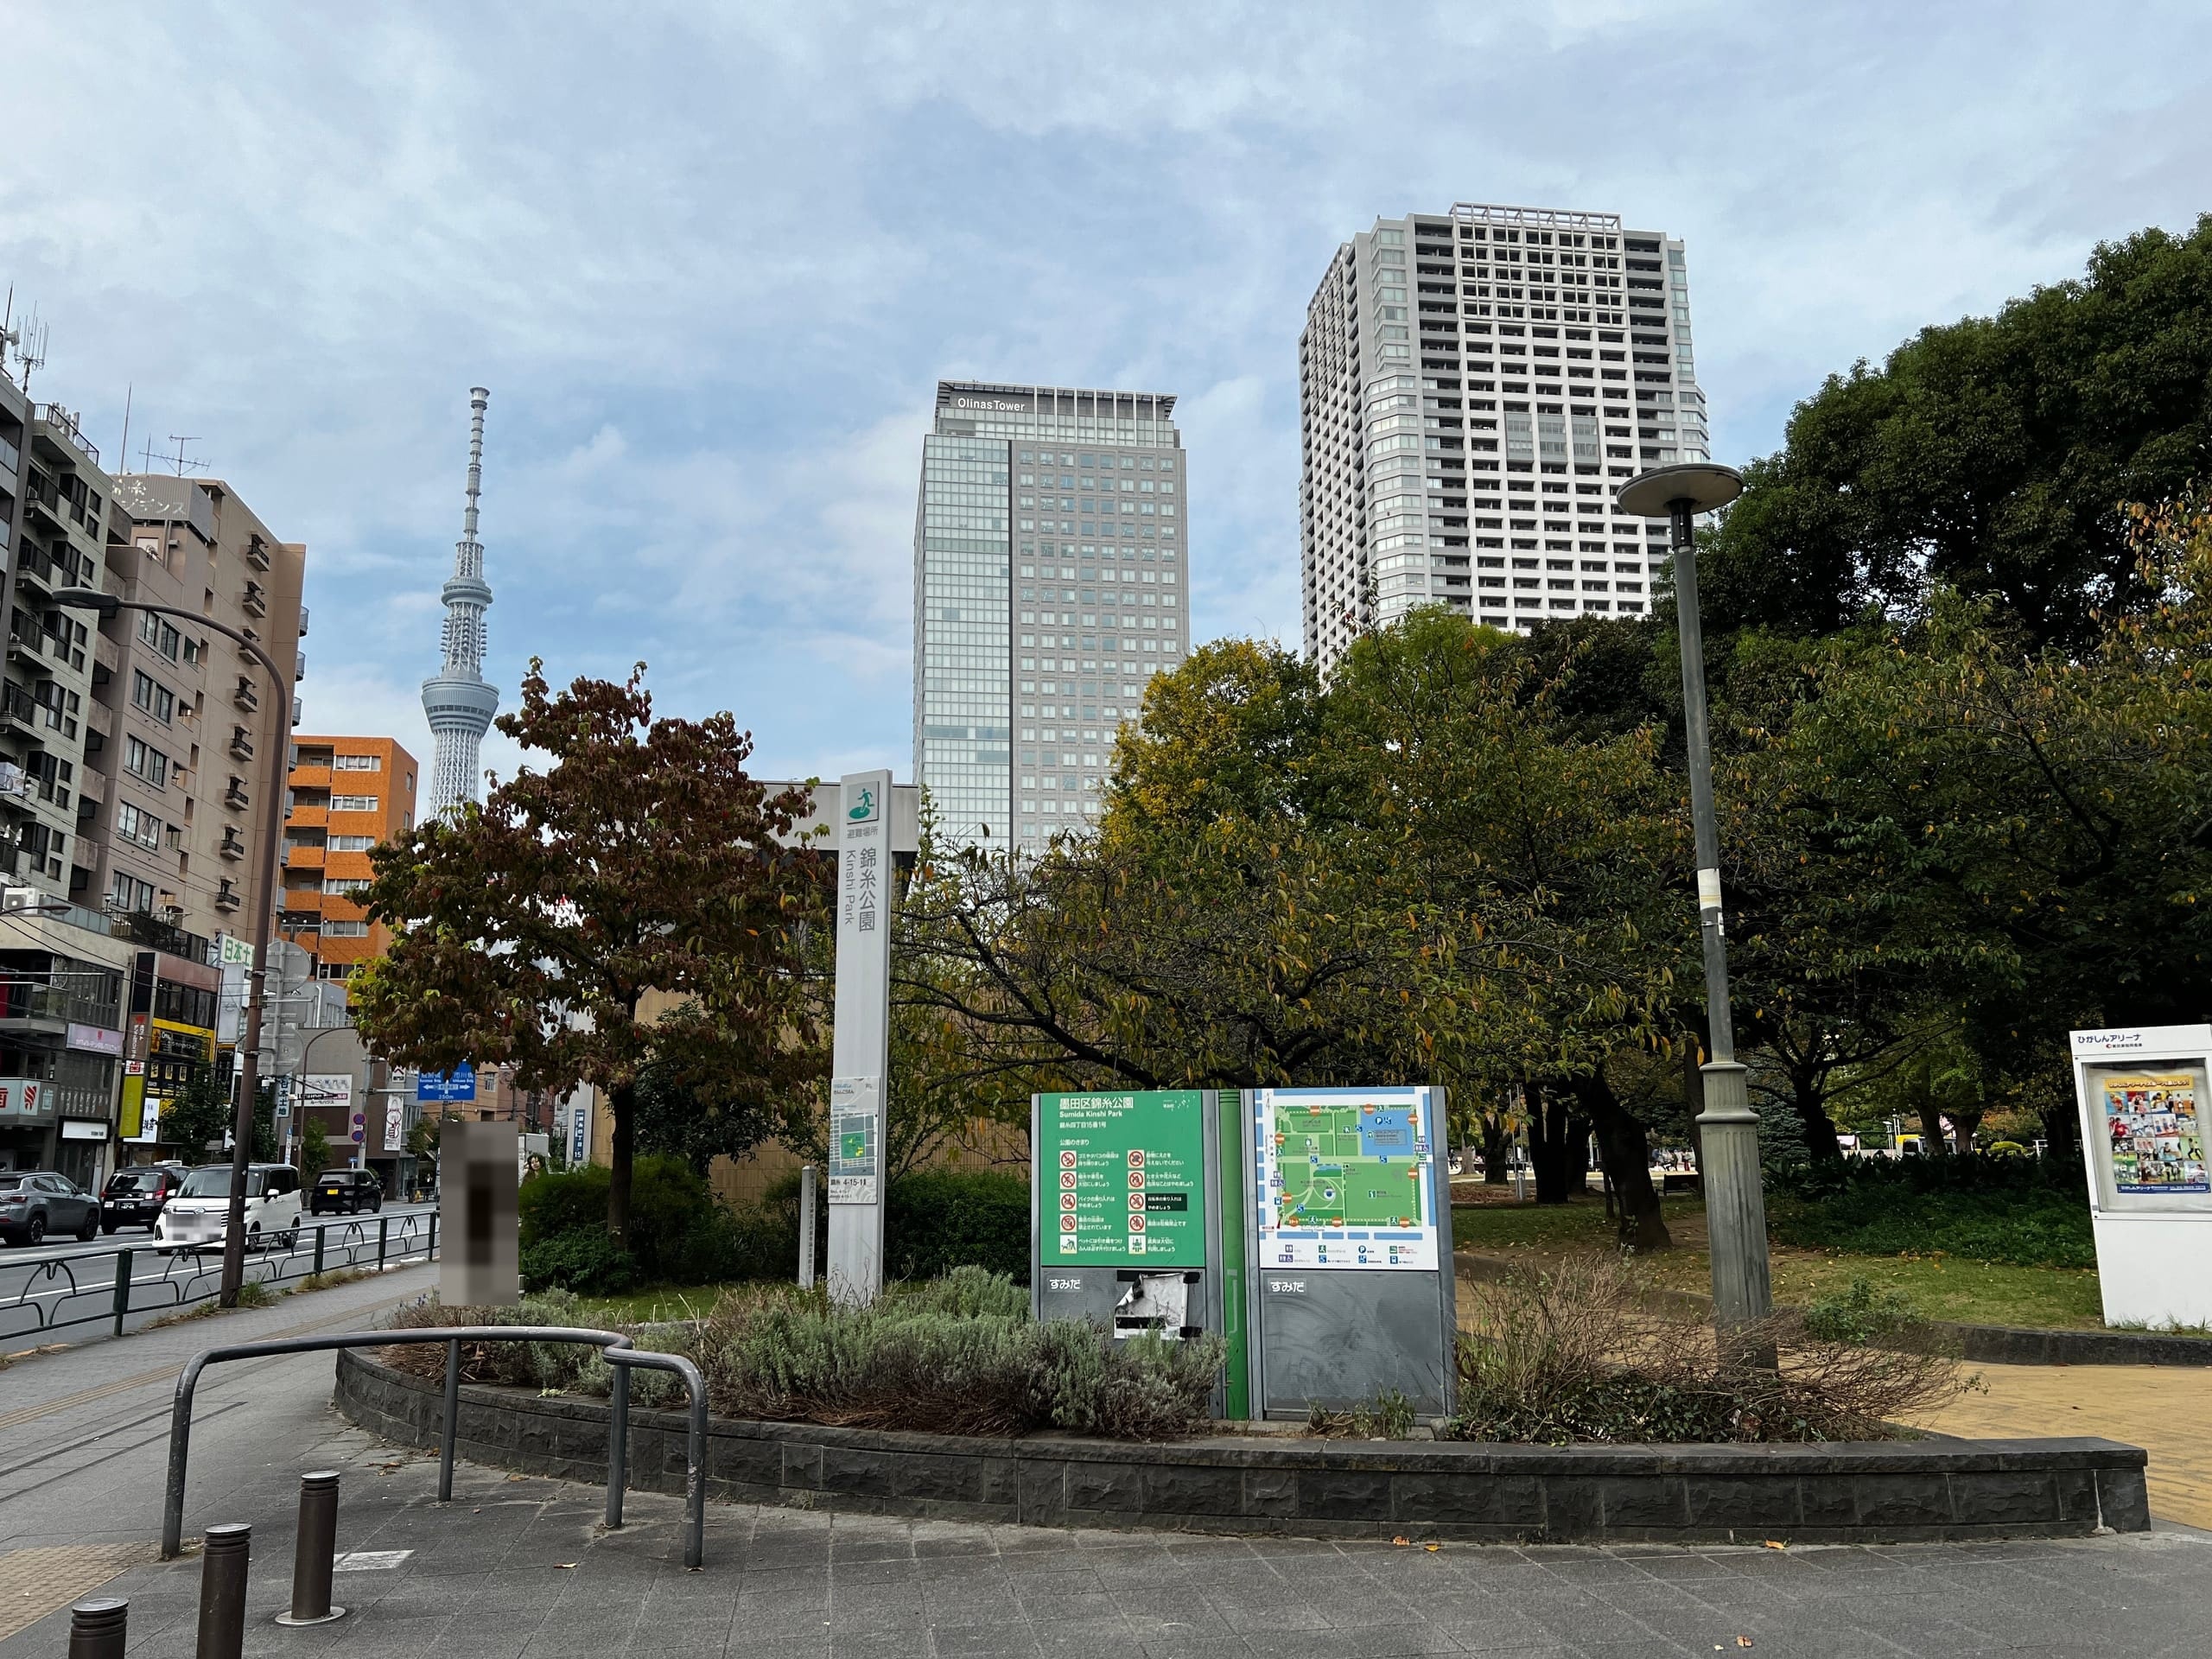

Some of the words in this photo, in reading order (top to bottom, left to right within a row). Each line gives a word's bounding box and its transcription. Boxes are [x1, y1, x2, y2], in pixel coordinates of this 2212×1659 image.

[957, 397, 993, 410] Olinas
[994, 400, 1025, 411] Tower
[847, 826, 878, 839] 避難場所
[846, 849, 856, 890] Kinshi
[859, 847, 876, 932] 錦糸公園
[844, 894, 855, 925] Park
[225, 938, 255, 968] 日本土
[2077, 1033, 2141, 1044] ひがしんアリーナ
[1059, 1096, 1134, 1109] 墨田区錦糸公園
[1049, 1278, 1081, 1290] すみだ
[1270, 1281, 1305, 1293] すみだ
